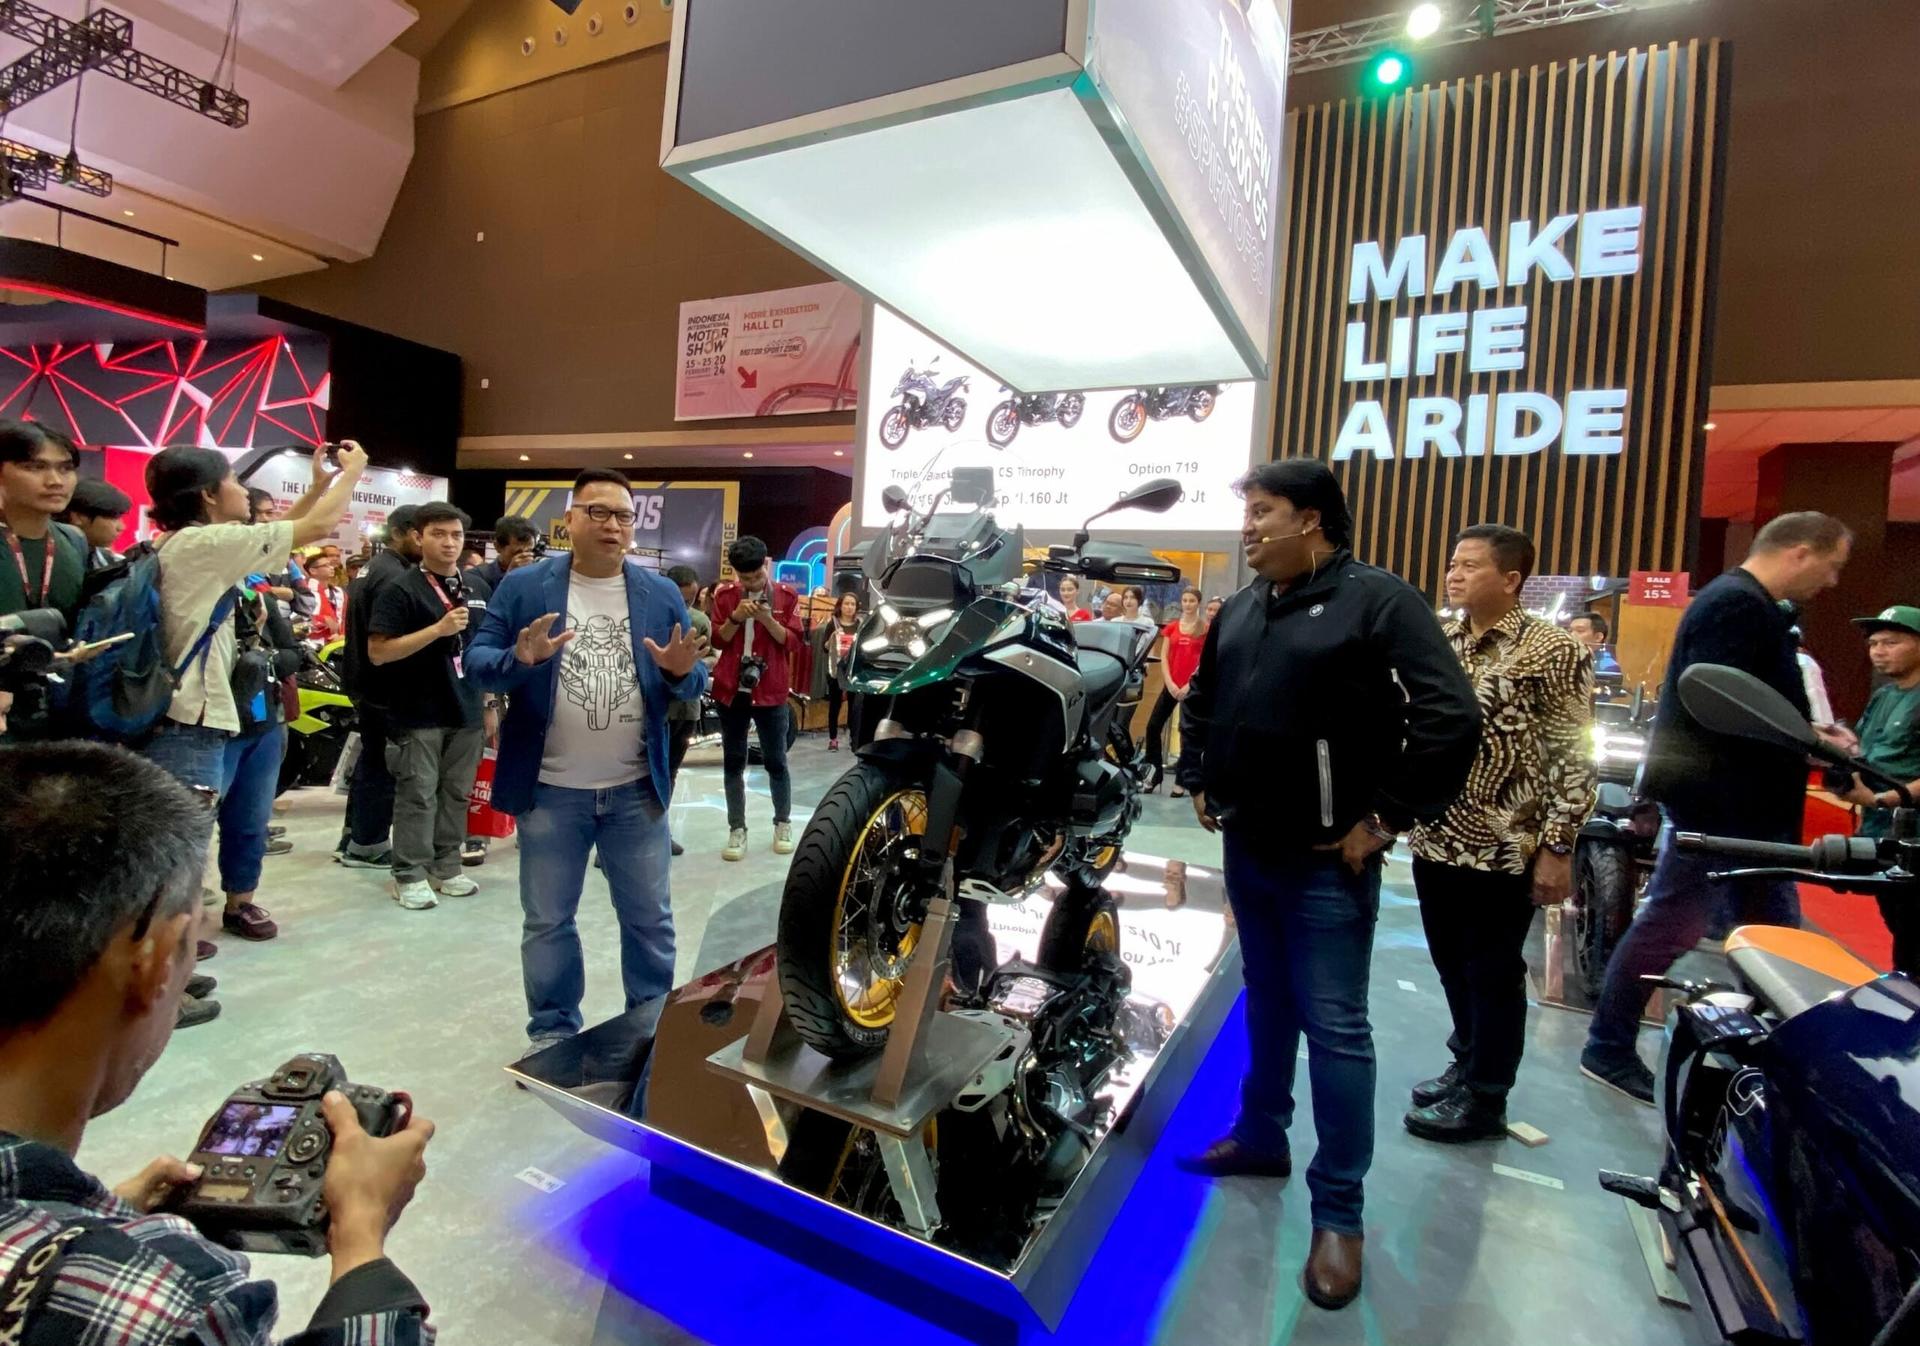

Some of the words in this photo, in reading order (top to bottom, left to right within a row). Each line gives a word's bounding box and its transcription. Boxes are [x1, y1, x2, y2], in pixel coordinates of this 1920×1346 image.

[1245, 92, 1271, 189] NEW
[1207, 60, 1218, 126] R
[1222, 100, 1252, 203] 1300
[1252, 180, 1268, 241] GS
[1348, 205, 1643, 305] MAKE
[687, 313, 730, 324] INDONESIA
[743, 320, 769, 331] HALL
[686, 328, 729, 342] MOTOR
[686, 341, 727, 357] SHOW
[1343, 305, 1528, 382] LIFE
[891, 469, 918, 480] Triple
[1128, 463, 1171, 477] Option
[1175, 461, 1199, 473] 719
[281, 481, 300, 494] THE
[1191, 490, 1205, 503] Jt
